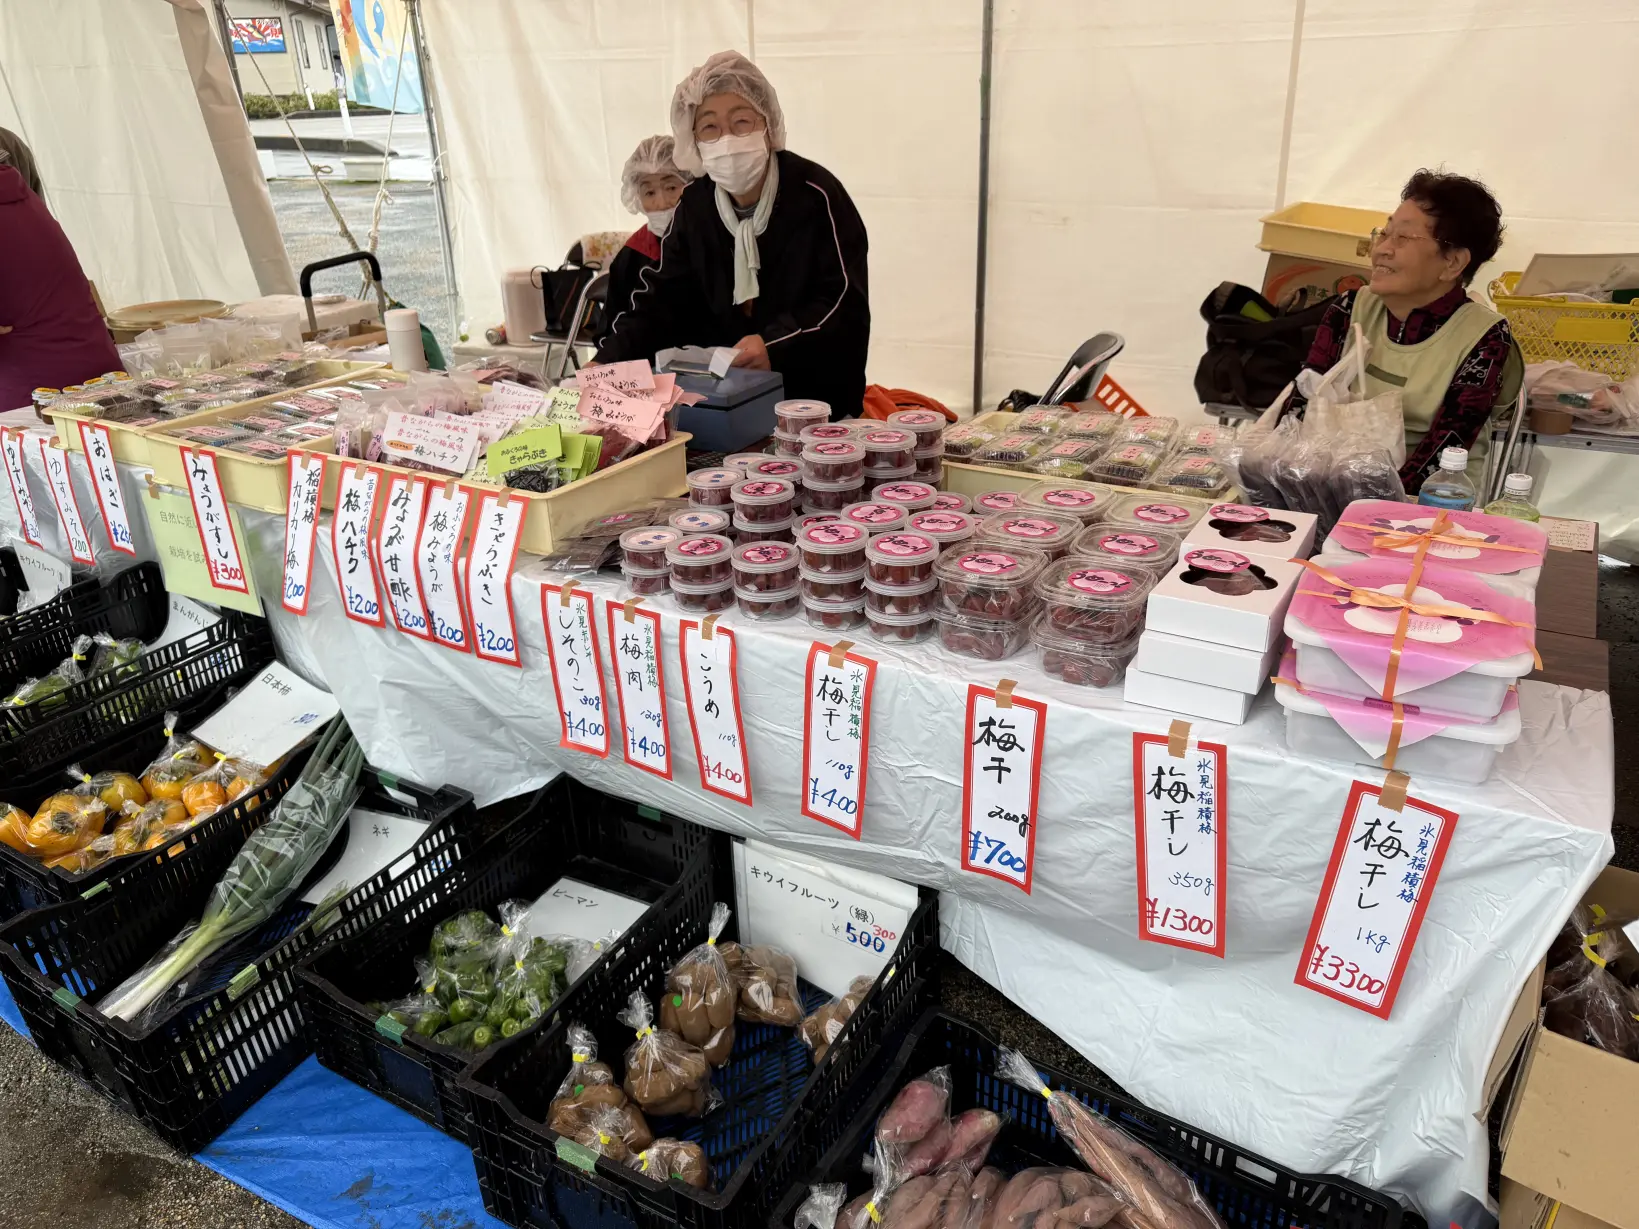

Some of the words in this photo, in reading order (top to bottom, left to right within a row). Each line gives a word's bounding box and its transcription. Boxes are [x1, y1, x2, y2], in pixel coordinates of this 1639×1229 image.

[397, 428, 465, 452] 昔ながらの梅風味
[414, 445, 459, 463] 梅ハチク
[509, 448, 548, 465] きゃらぶき
[93, 438, 119, 509] おはぎ
[286, 481, 302, 570] カリカリ梅
[342, 488, 362, 574] 梅ハチク
[384, 488, 413, 603] みょうが甘酢
[428, 510, 448, 593] 梅みょうが
[477, 512, 506, 606] きゃらぶき
[211, 559, 242, 581] ¥300
[346, 585, 379, 615] ¥200
[391, 600, 426, 629] ¥200
[427, 608, 464, 643] ¥200
[476, 622, 515, 652] ¥200
[559, 610, 584, 692] しそのこ
[620, 633, 644, 692] 梅肉
[261, 673, 293, 696] 日本柿
[700, 653, 720, 719] こうめ
[563, 711, 606, 738] ¥400
[816, 674, 849, 742] 梅干し
[627, 726, 666, 758] ¥400
[972, 716, 1026, 785] 梅干
[703, 755, 743, 784] ¥400
[825, 759, 855, 780] 110g
[810, 777, 858, 815] ¥400
[1146, 765, 1196, 857] 梅干し
[1196, 759, 1218, 835] 氷見稲積梅
[372, 824, 390, 838] ネギ
[987, 805, 1033, 838] 200g
[969, 830, 1027, 874] ¥700
[1353, 817, 1409, 910] 梅干し
[1396, 822, 1436, 903] 氷見稲積梅
[750, 865, 840, 910] キウイフルーツ
[1168, 872, 1215, 896] 350g
[872, 924, 897, 940] 300
[1145, 897, 1214, 936] ¥1300
[845, 921, 886, 953] 500
[1310, 944, 1385, 995] ¥3300
